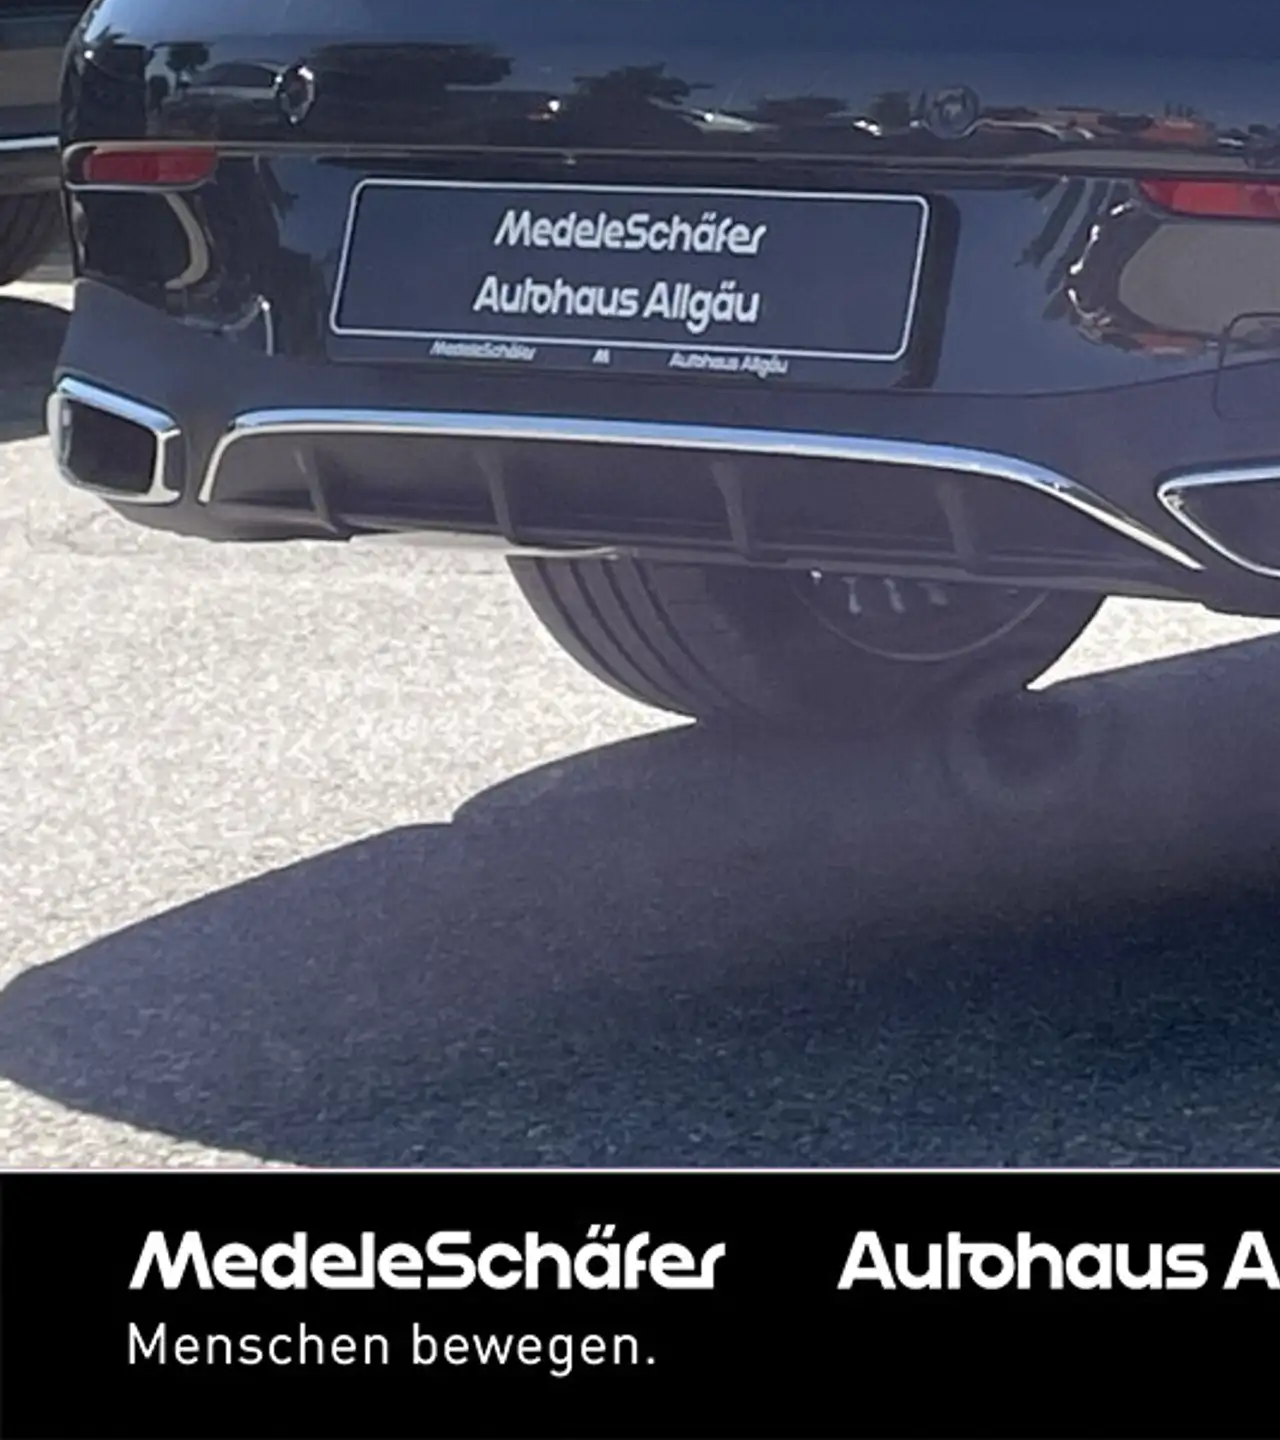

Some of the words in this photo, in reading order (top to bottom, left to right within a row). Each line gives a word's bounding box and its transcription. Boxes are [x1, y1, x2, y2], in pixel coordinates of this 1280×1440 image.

[493, 209, 767, 254] MedeleSchäfer
[472, 275, 641, 318] Autohaus
[642, 280, 760, 334] Allgäu
